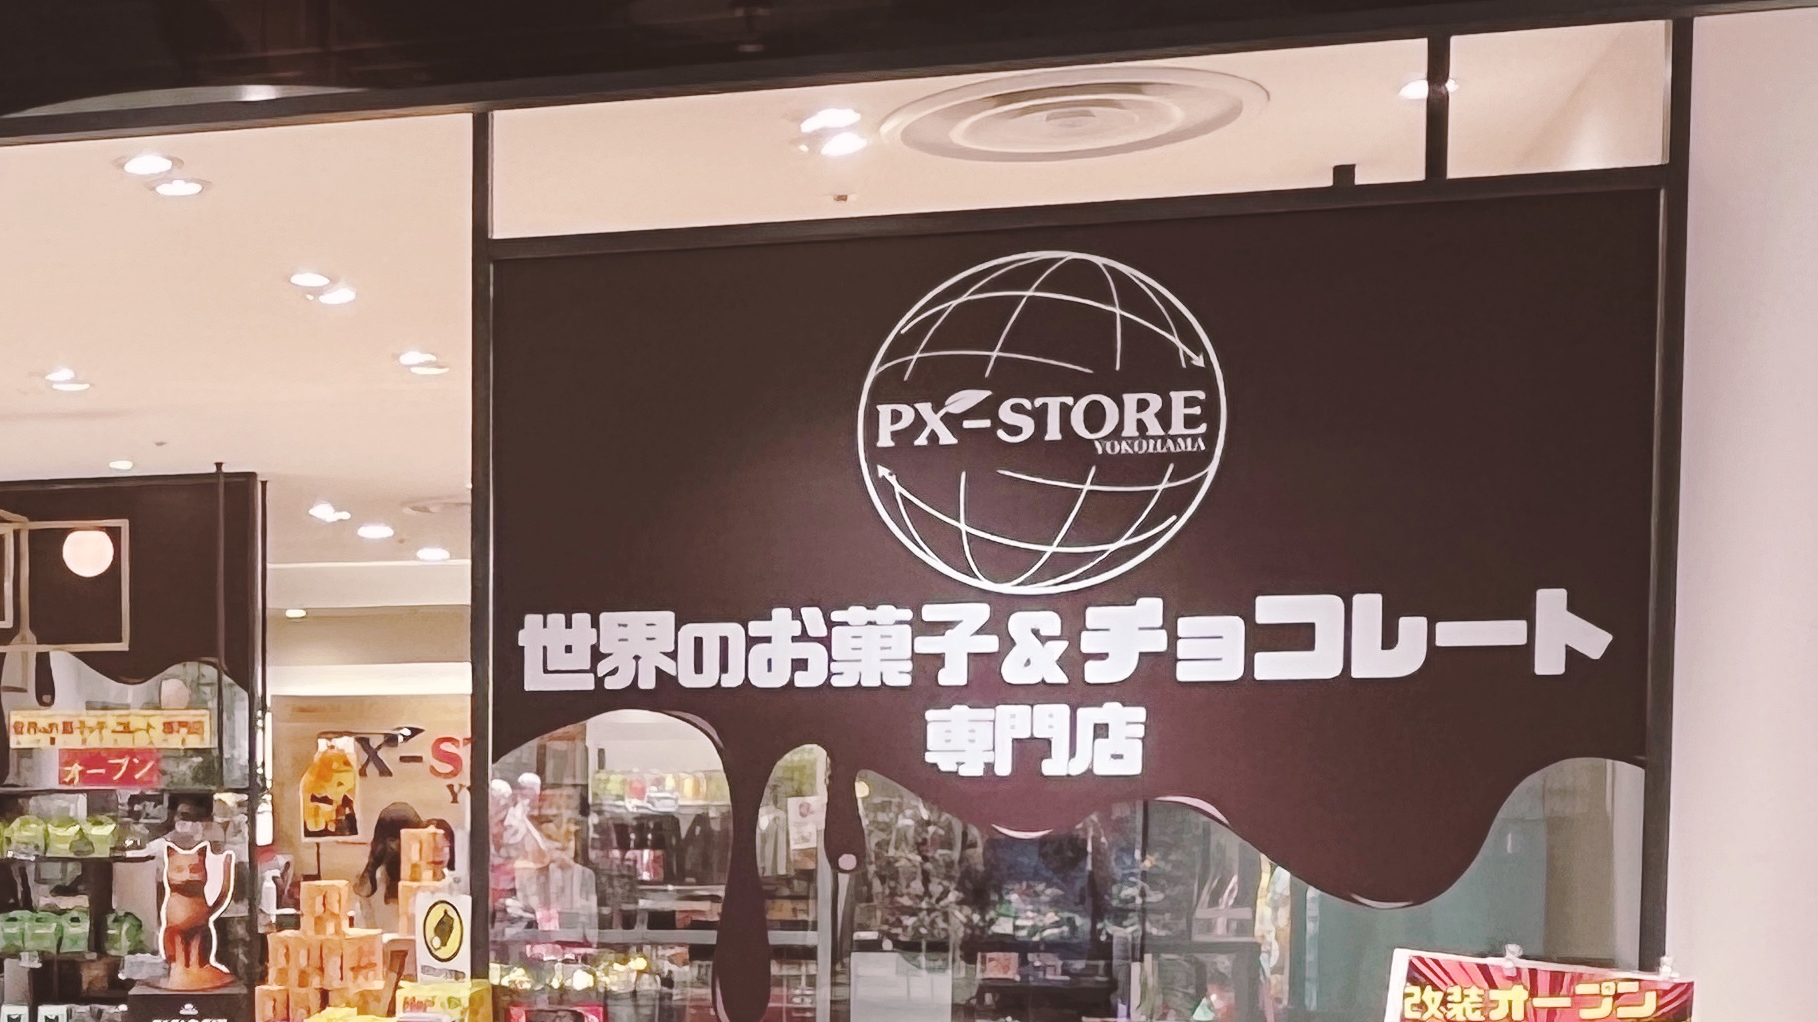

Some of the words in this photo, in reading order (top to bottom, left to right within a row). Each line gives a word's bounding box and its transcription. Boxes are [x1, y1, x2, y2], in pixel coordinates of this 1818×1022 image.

[876, 389, 1207, 447] PX-STORE
[1094, 437, 1206, 456] YOKOHAMA
[924, 703, 1147, 779] 専門店
[1403, 981, 1657, 1022] 改装オープン
